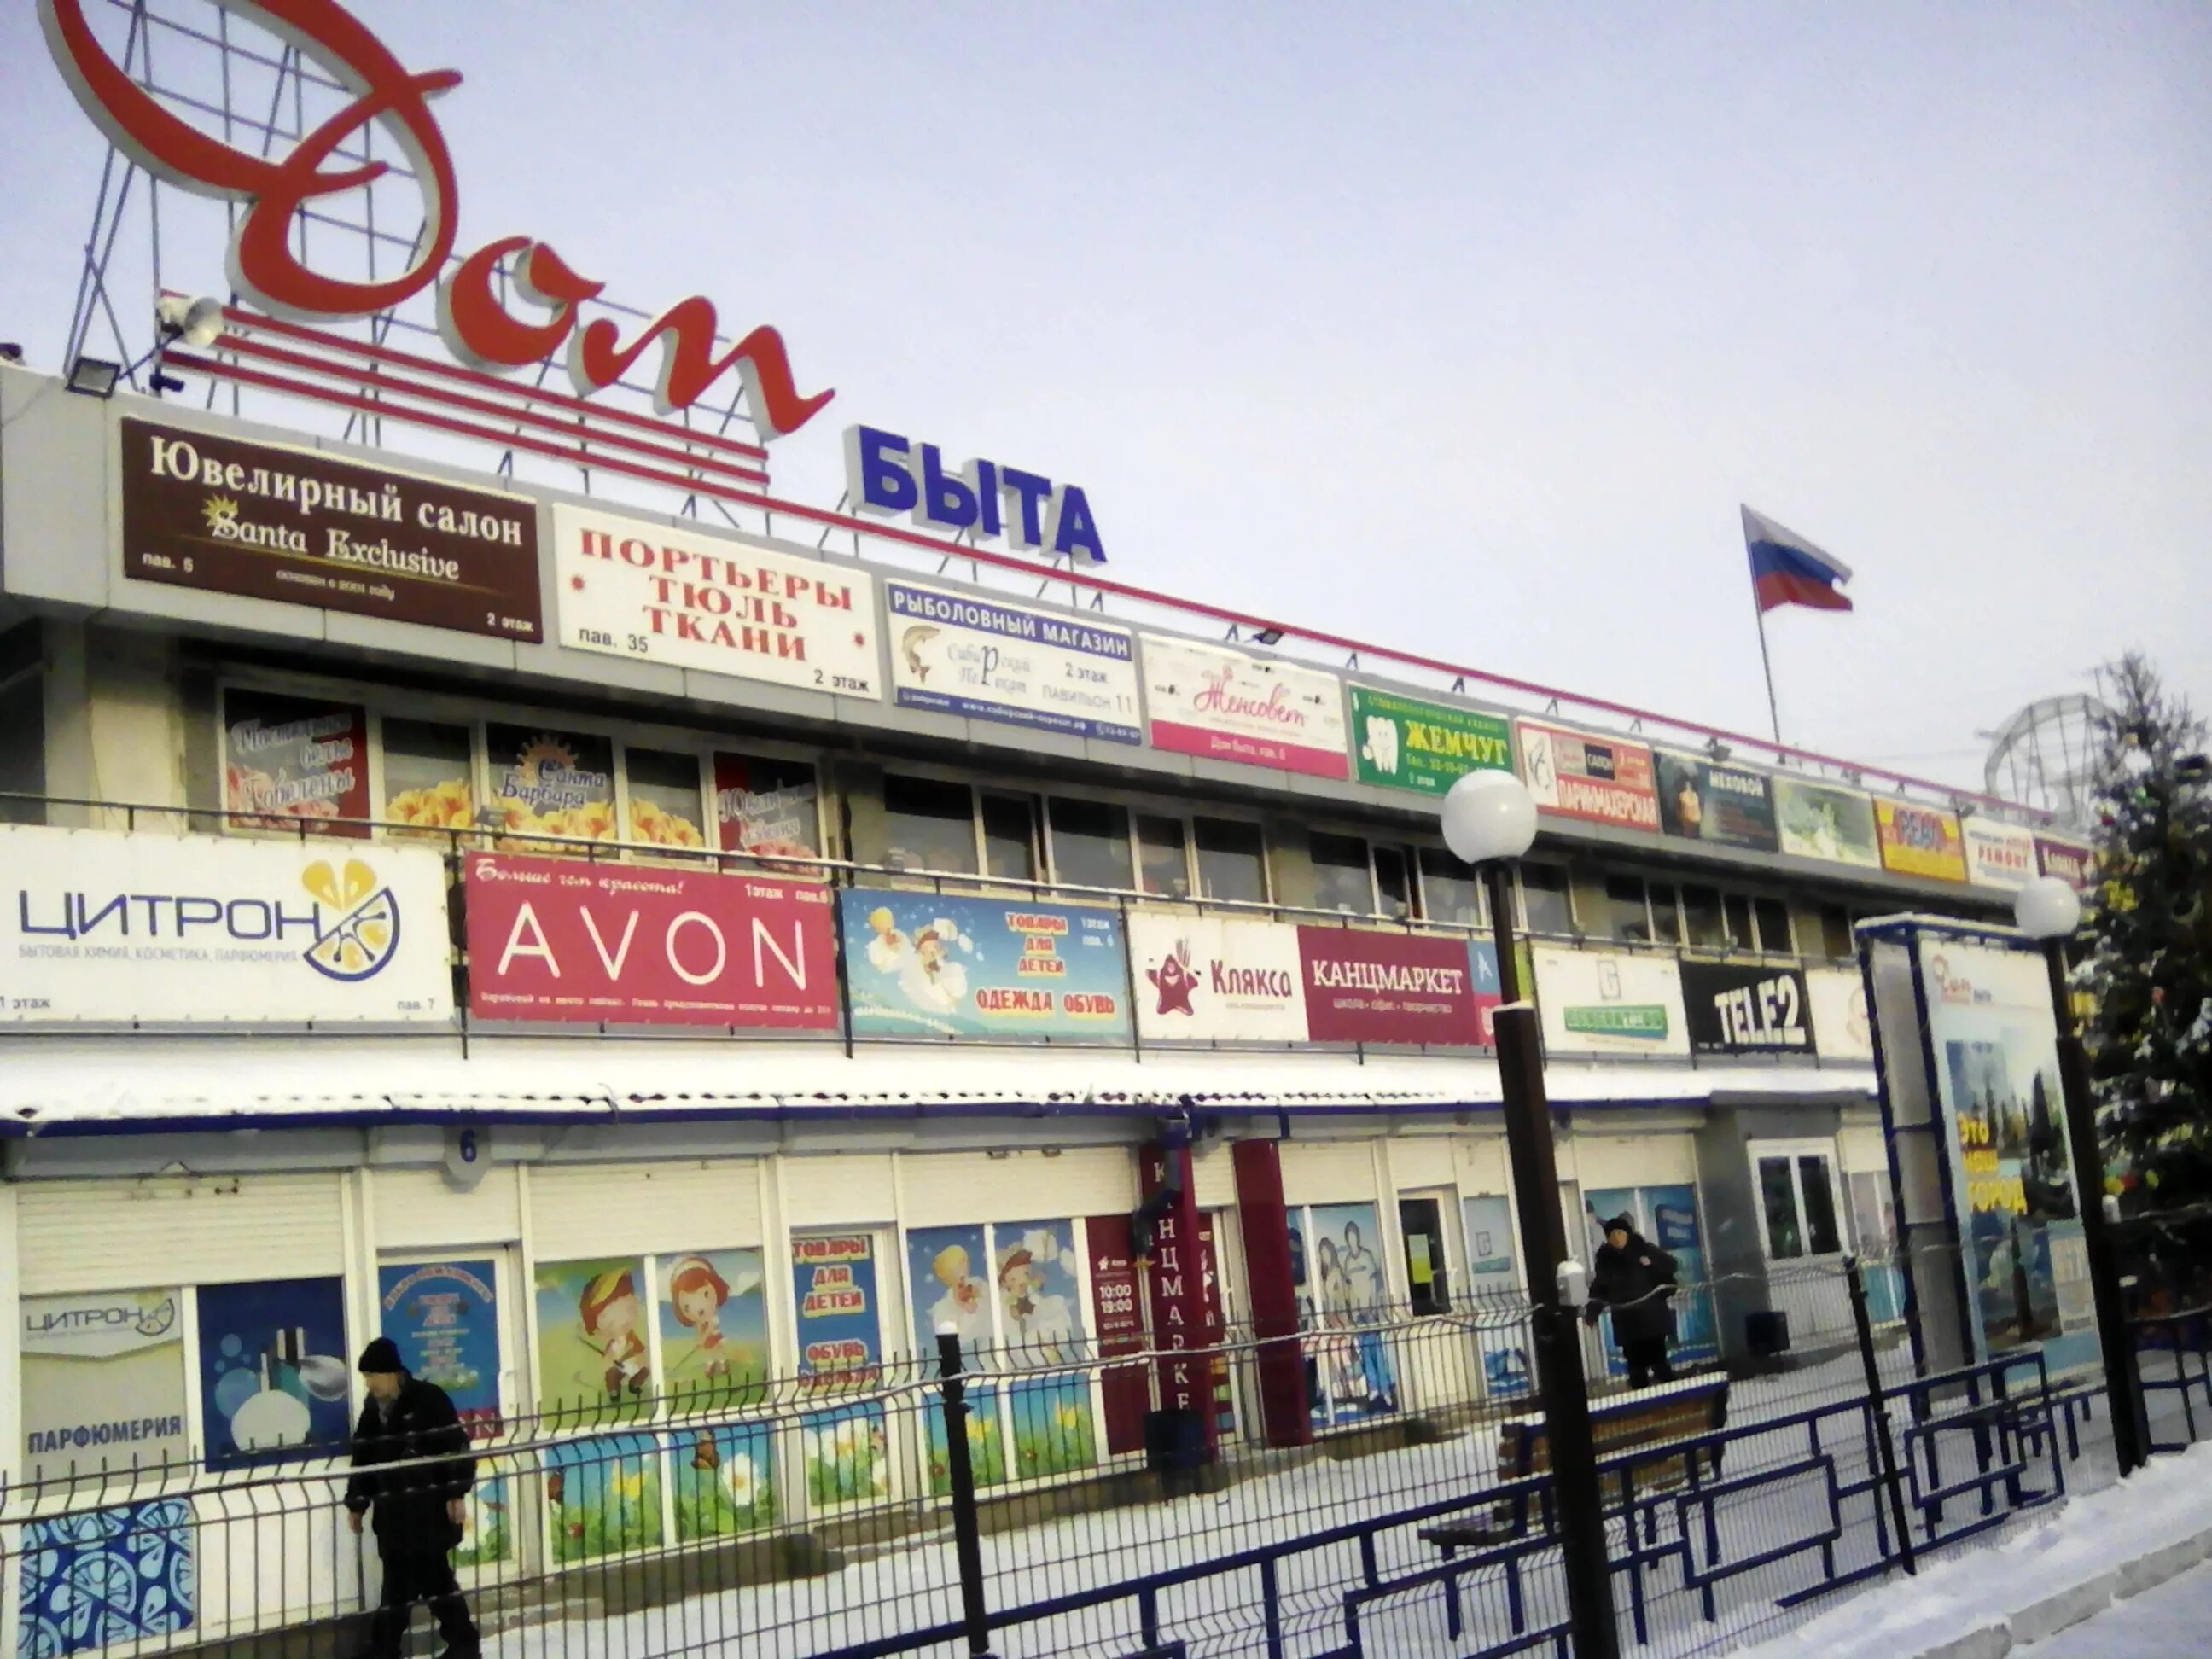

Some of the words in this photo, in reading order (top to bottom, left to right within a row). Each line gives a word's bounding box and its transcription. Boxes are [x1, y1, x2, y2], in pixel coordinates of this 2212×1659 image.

[150, 436, 403, 523] Ювелирный
[417, 500, 523, 546] салон
[847, 424, 1108, 565] БЫТА
[212, 509, 307, 555] Santa
[326, 528, 459, 580] Exclusive
[579, 527, 853, 611] ПОРТЬЕРЫ
[649, 575, 799, 630] ТЮЛЬ
[487, 612, 496, 626] 2
[642, 605, 807, 662] ТКАНИ
[893, 589, 1036, 638] РЫБОЛОВНЫЙ
[1042, 623, 1129, 657] МАГАЗИН
[579, 627, 617, 649] пав.
[627, 633, 649, 654] 35
[813, 669, 824, 684] 2
[831, 673, 870, 693] этаж
[1064, 661, 1074, 678] 2
[1077, 666, 1109, 684] этаж
[1042, 684, 1111, 711] ПАВИЛЬОН
[1194, 665, 1306, 727] Женсовет
[1405, 719, 1508, 766] ЖЕМЧУГ
[502, 772, 587, 806] Барбара
[19, 889, 321, 940] ЦИТРОН
[1007, 913, 1068, 934] ТОВАРЫ
[19, 943, 79, 959] БЫТОВАЯ
[215, 948, 298, 963] ПАРФЮМЕРИЯ
[498, 900, 806, 990] AVON
[1025, 936, 1054, 954] ДЛЯ
[1018, 957, 1064, 975] ДЕТЕЙ
[1210, 959, 1292, 998] Клякса
[1312, 959, 1462, 994] КАНЦМАРКЕТ
[13, 998, 50, 1010] этаж
[976, 987, 1054, 1014] ОДЕЖДА
[1063, 992, 1116, 1016] ОБУВЬ
[1714, 975, 1806, 1045] TELE2
[460, 1130, 476, 1161] 6
[792, 1239, 868, 1261] ТОВАРЫ
[813, 1266, 851, 1290] ДЛЯ
[1099, 1284, 1132, 1300] 10:00
[804, 1291, 864, 1316] ДЕТЕЙ
[26, 1307, 143, 1332] ЦИТРОН
[807, 1342, 866, 1363] ОБУВЬ
[28, 1415, 182, 1453] ПАРФЮМЕРИЯ
